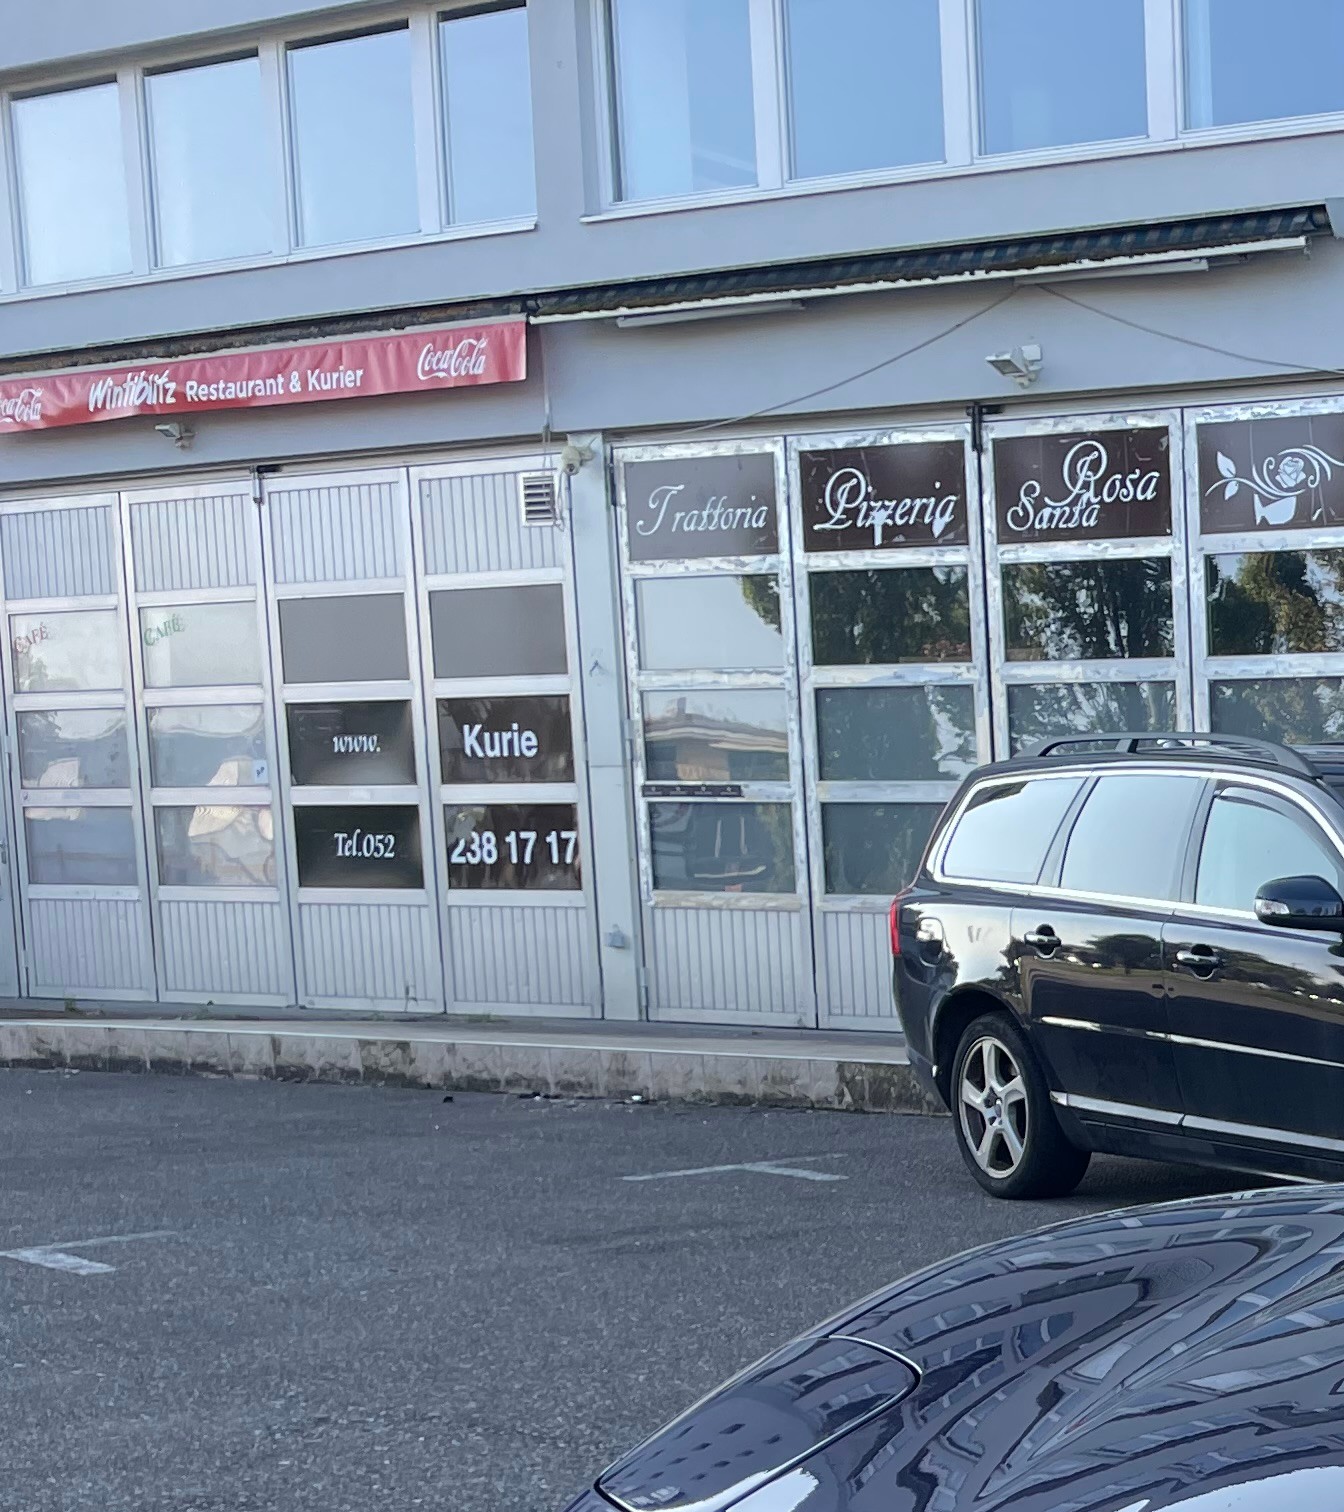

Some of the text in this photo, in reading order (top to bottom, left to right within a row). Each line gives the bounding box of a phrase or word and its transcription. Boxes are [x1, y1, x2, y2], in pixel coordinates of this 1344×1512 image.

[88, 365, 364, 412] Wintiblitz Restaurant & Kurier
[813, 467, 958, 532] Pizzeria
[1007, 440, 1160, 531] Santa Rosa
[636, 484, 768, 536] Trattoria
[333, 734, 381, 753] www.
[462, 722, 539, 758] Kurie
[333, 829, 395, 859] Tel.052
[450, 830, 578, 865] 238 17 17
